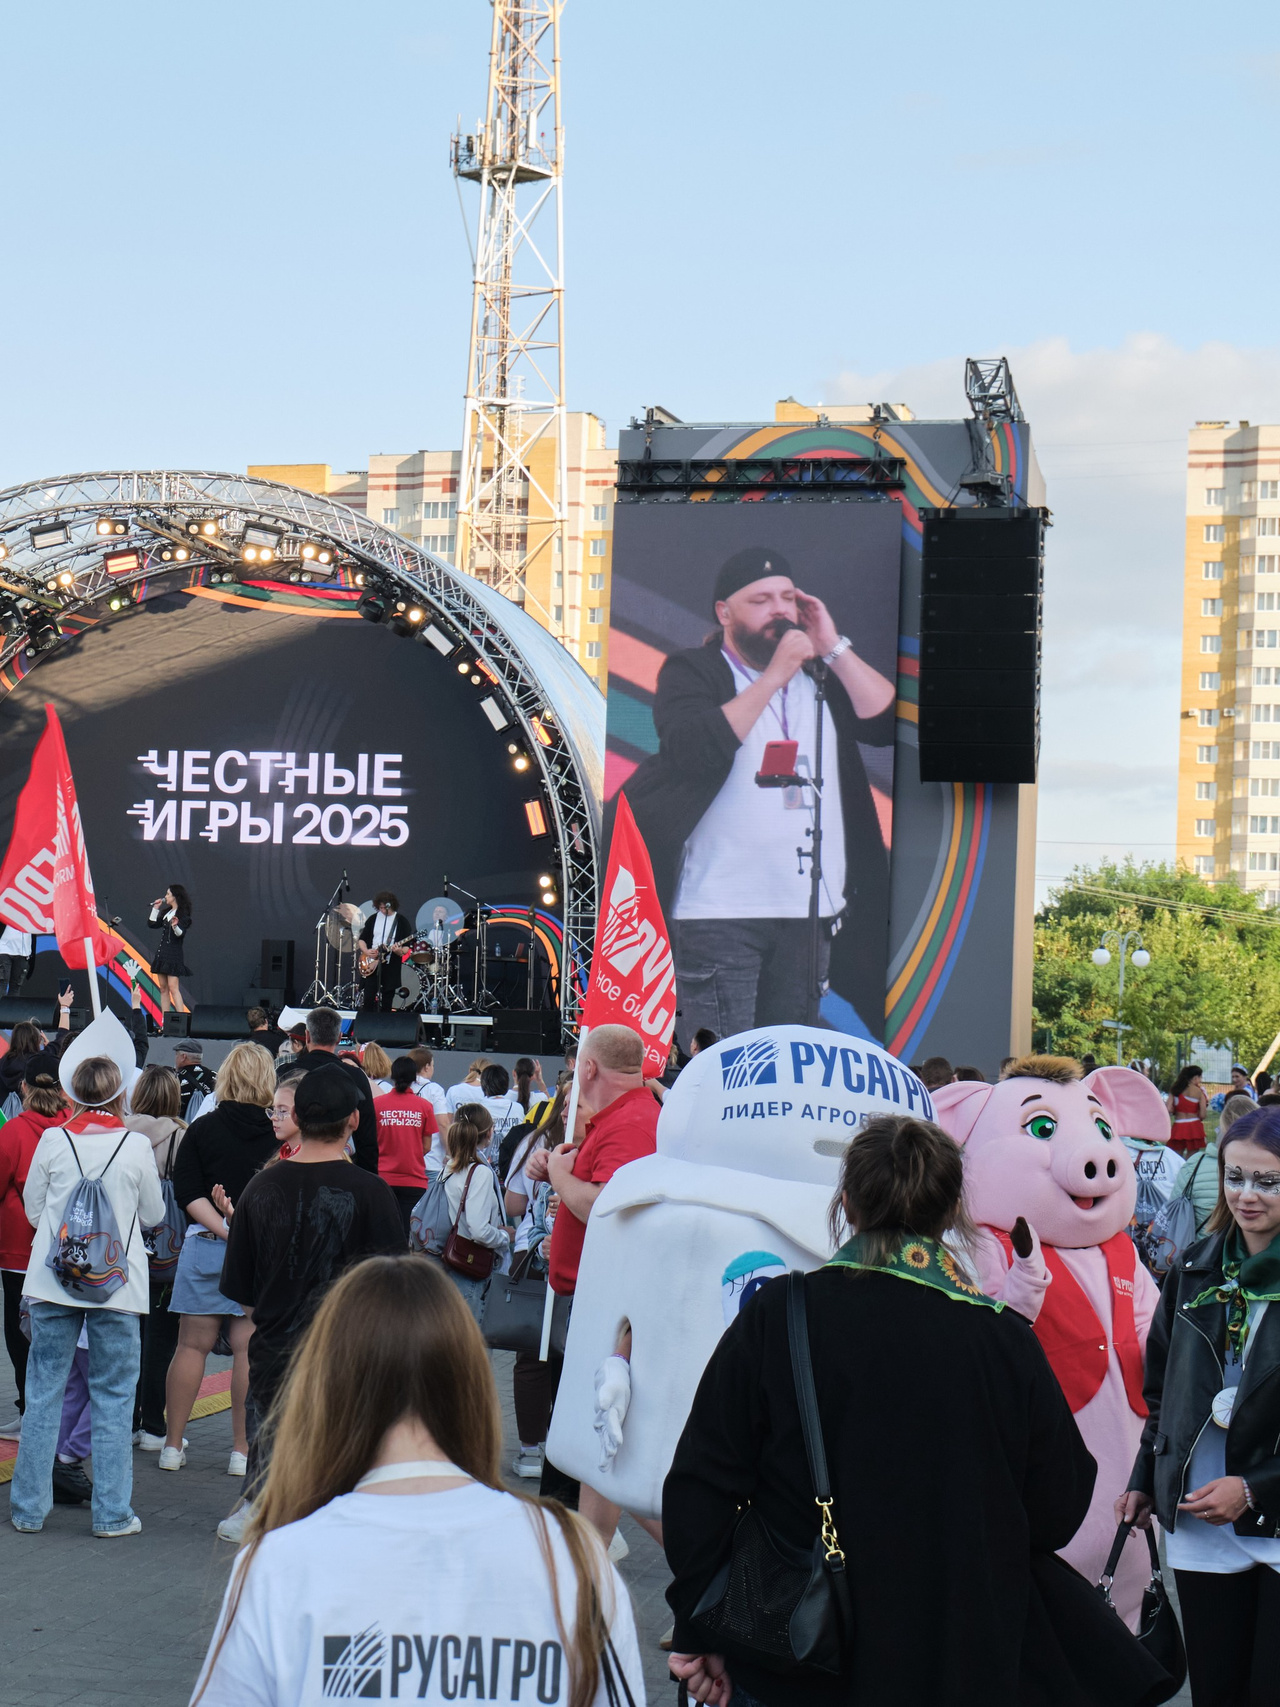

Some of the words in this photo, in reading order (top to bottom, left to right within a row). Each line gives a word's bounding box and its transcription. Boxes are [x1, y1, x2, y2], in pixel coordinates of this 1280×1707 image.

[136, 749, 404, 797] ЧЕСТНЫЕ
[126, 799, 285, 845] ИГРЫ
[292, 802, 410, 848] 2025
[790, 1041, 933, 1122] РУСАГРО
[379, 1110, 422, 1120] ЧЕСТНЫЕ
[379, 1118, 404, 1126] ИГРЫ
[405, 1119, 422, 1128] 2025
[721, 1101, 793, 1121] ЛИДЕР
[390, 1634, 562, 1705] РУСАГРО
